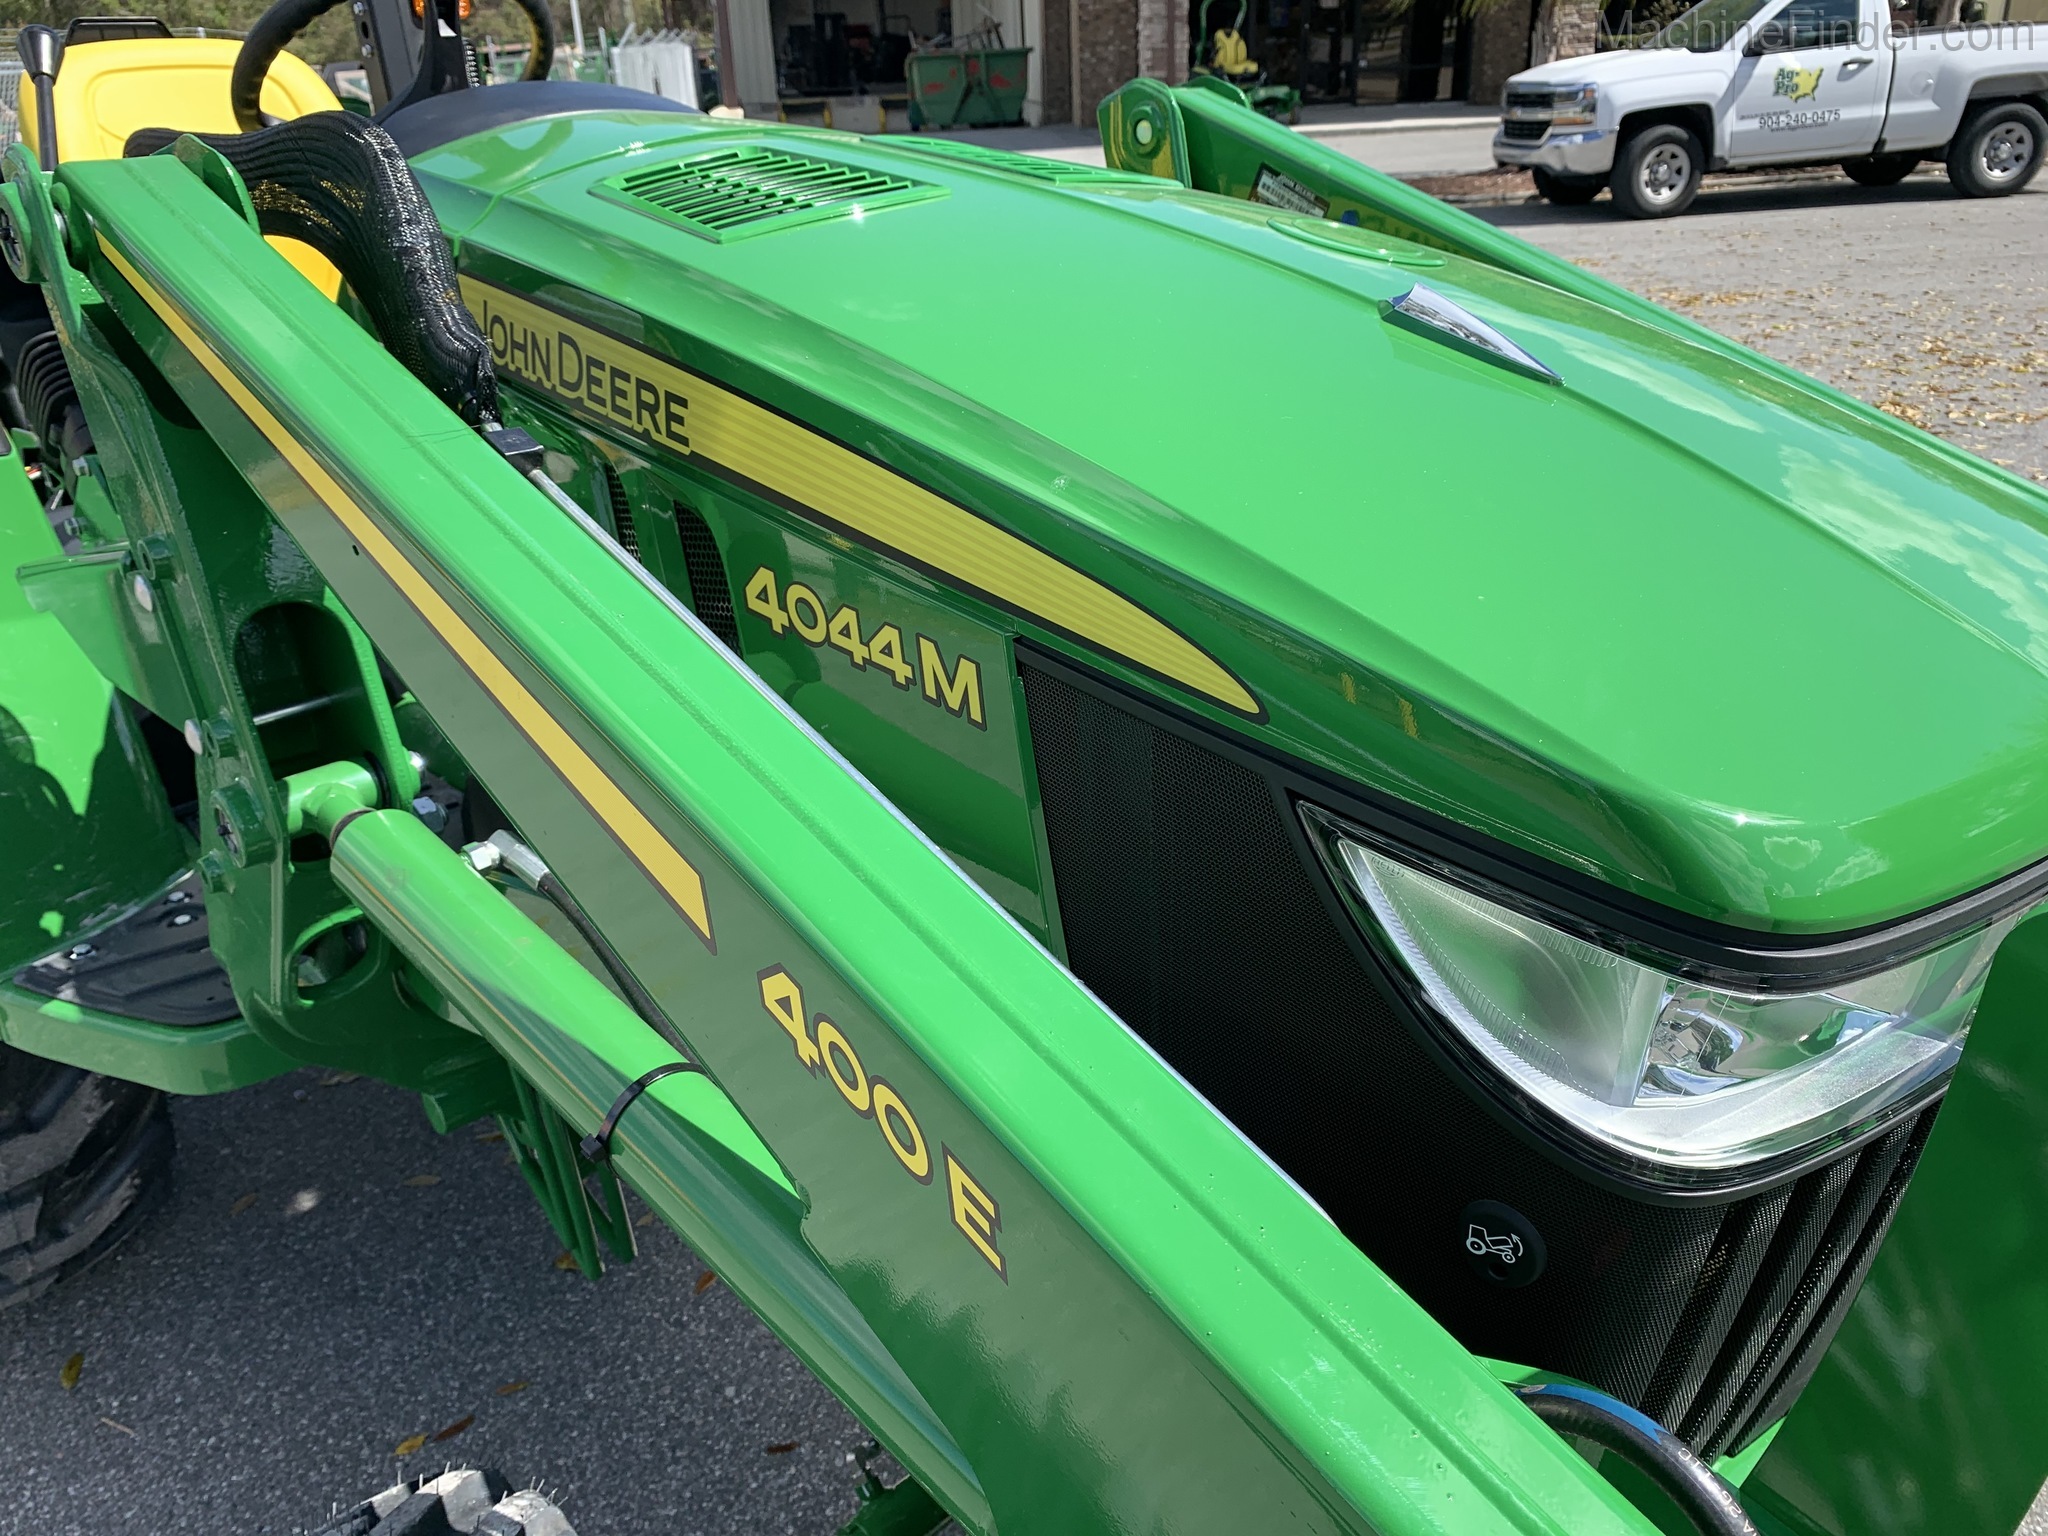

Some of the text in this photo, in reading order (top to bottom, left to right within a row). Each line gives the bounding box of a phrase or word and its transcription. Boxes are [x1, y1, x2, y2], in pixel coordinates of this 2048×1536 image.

[1759, 109, 1840, 129] 904-240-0475
[1776, 80, 1798, 94] Pro
[483, 300, 690, 449] JOHN DEERE
[744, 565, 987, 731] 4044M
